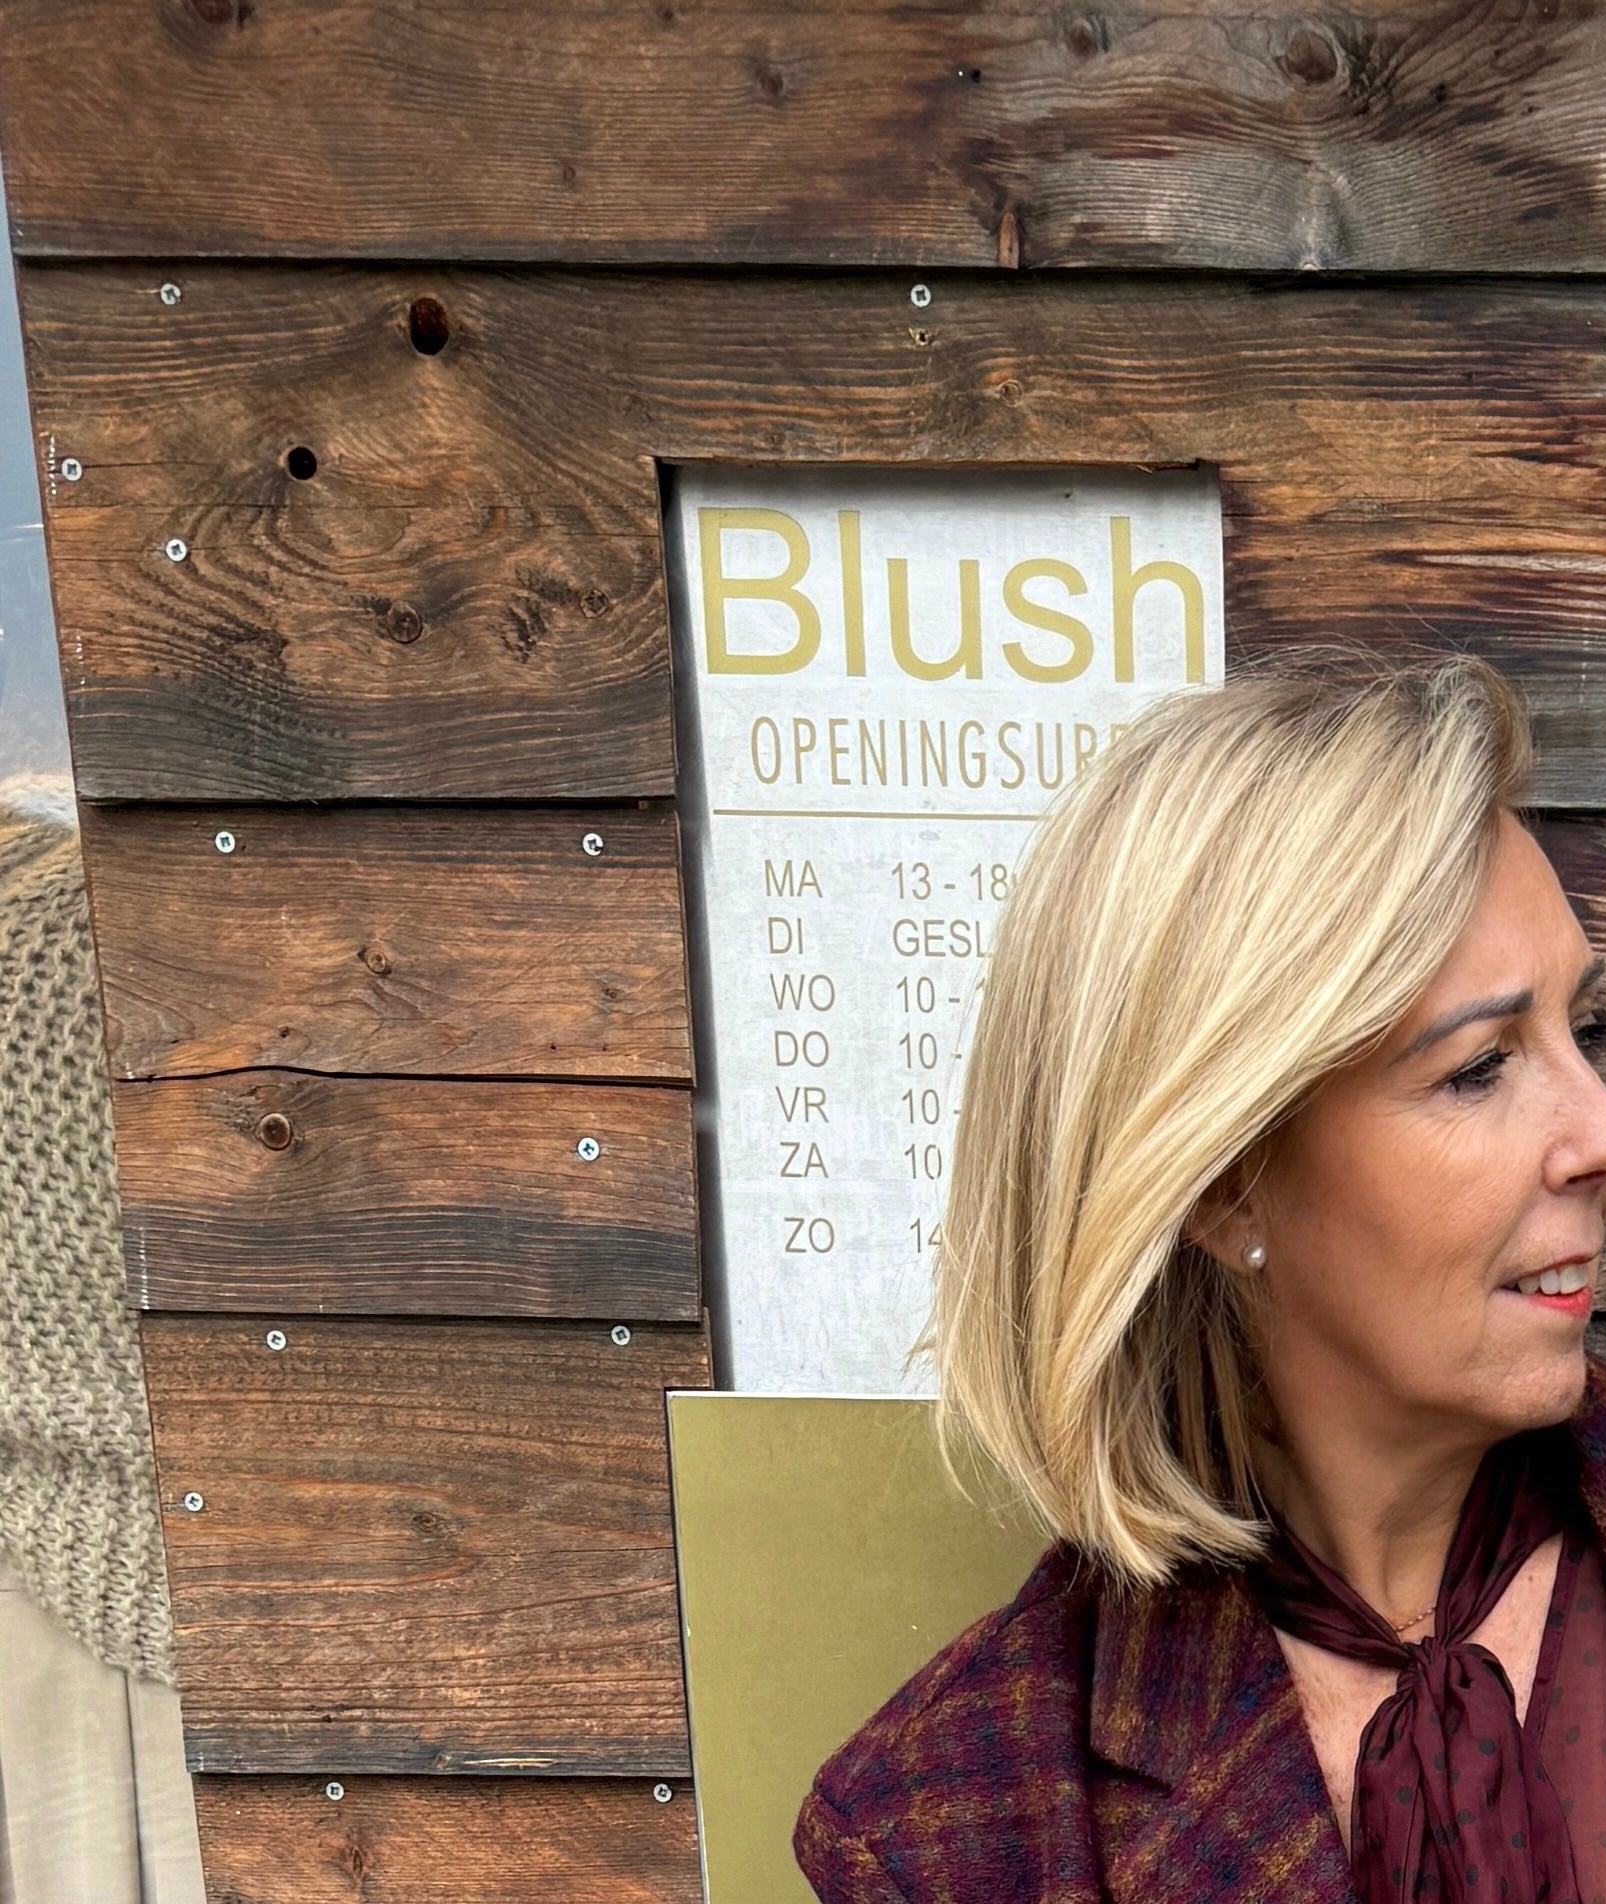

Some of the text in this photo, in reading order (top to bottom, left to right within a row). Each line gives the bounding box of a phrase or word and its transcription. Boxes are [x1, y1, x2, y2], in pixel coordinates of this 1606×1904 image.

[698, 507, 1206, 684] Blush
[751, 716, 1130, 790] OPENINGSUR
[764, 859, 823, 898] MA
[891, 862, 932, 901] 13
[969, 863, 1018, 902] 18
[767, 917, 994, 959] DI GESL
[769, 973, 836, 1012] WO
[896, 976, 936, 1013] 10
[774, 1030, 830, 1068] DO
[899, 1032, 938, 1069] 10
[775, 1086, 830, 1123] VR
[901, 1088, 940, 1125] 10
[779, 1141, 943, 1180] ZA 10
[783, 1216, 836, 1254] ZO
